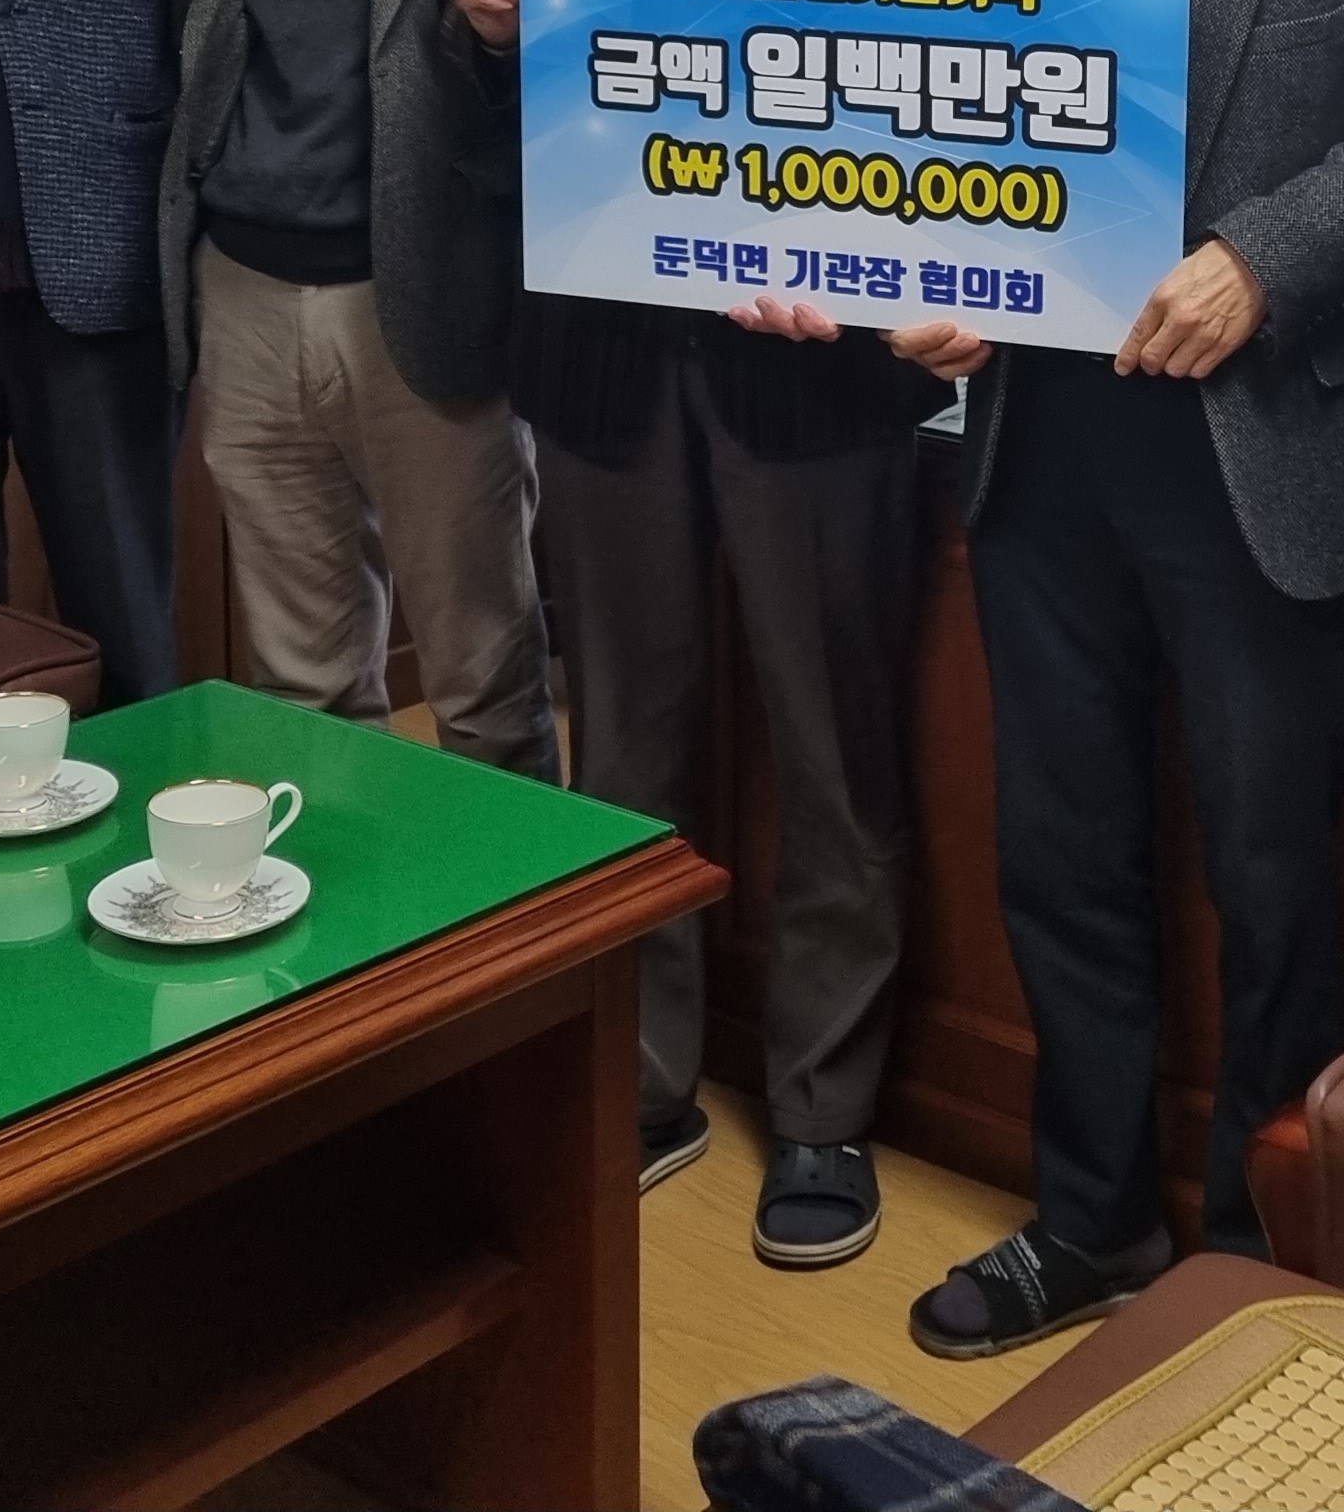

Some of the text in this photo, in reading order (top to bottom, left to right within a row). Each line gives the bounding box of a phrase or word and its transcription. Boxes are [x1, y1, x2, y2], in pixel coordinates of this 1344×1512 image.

[593, 31, 1112, 149] 금액 일백만원
[741, 149, 1062, 226] 1,000,000)
[652, 234, 1044, 314] 둔덕면 기관장 협의회
